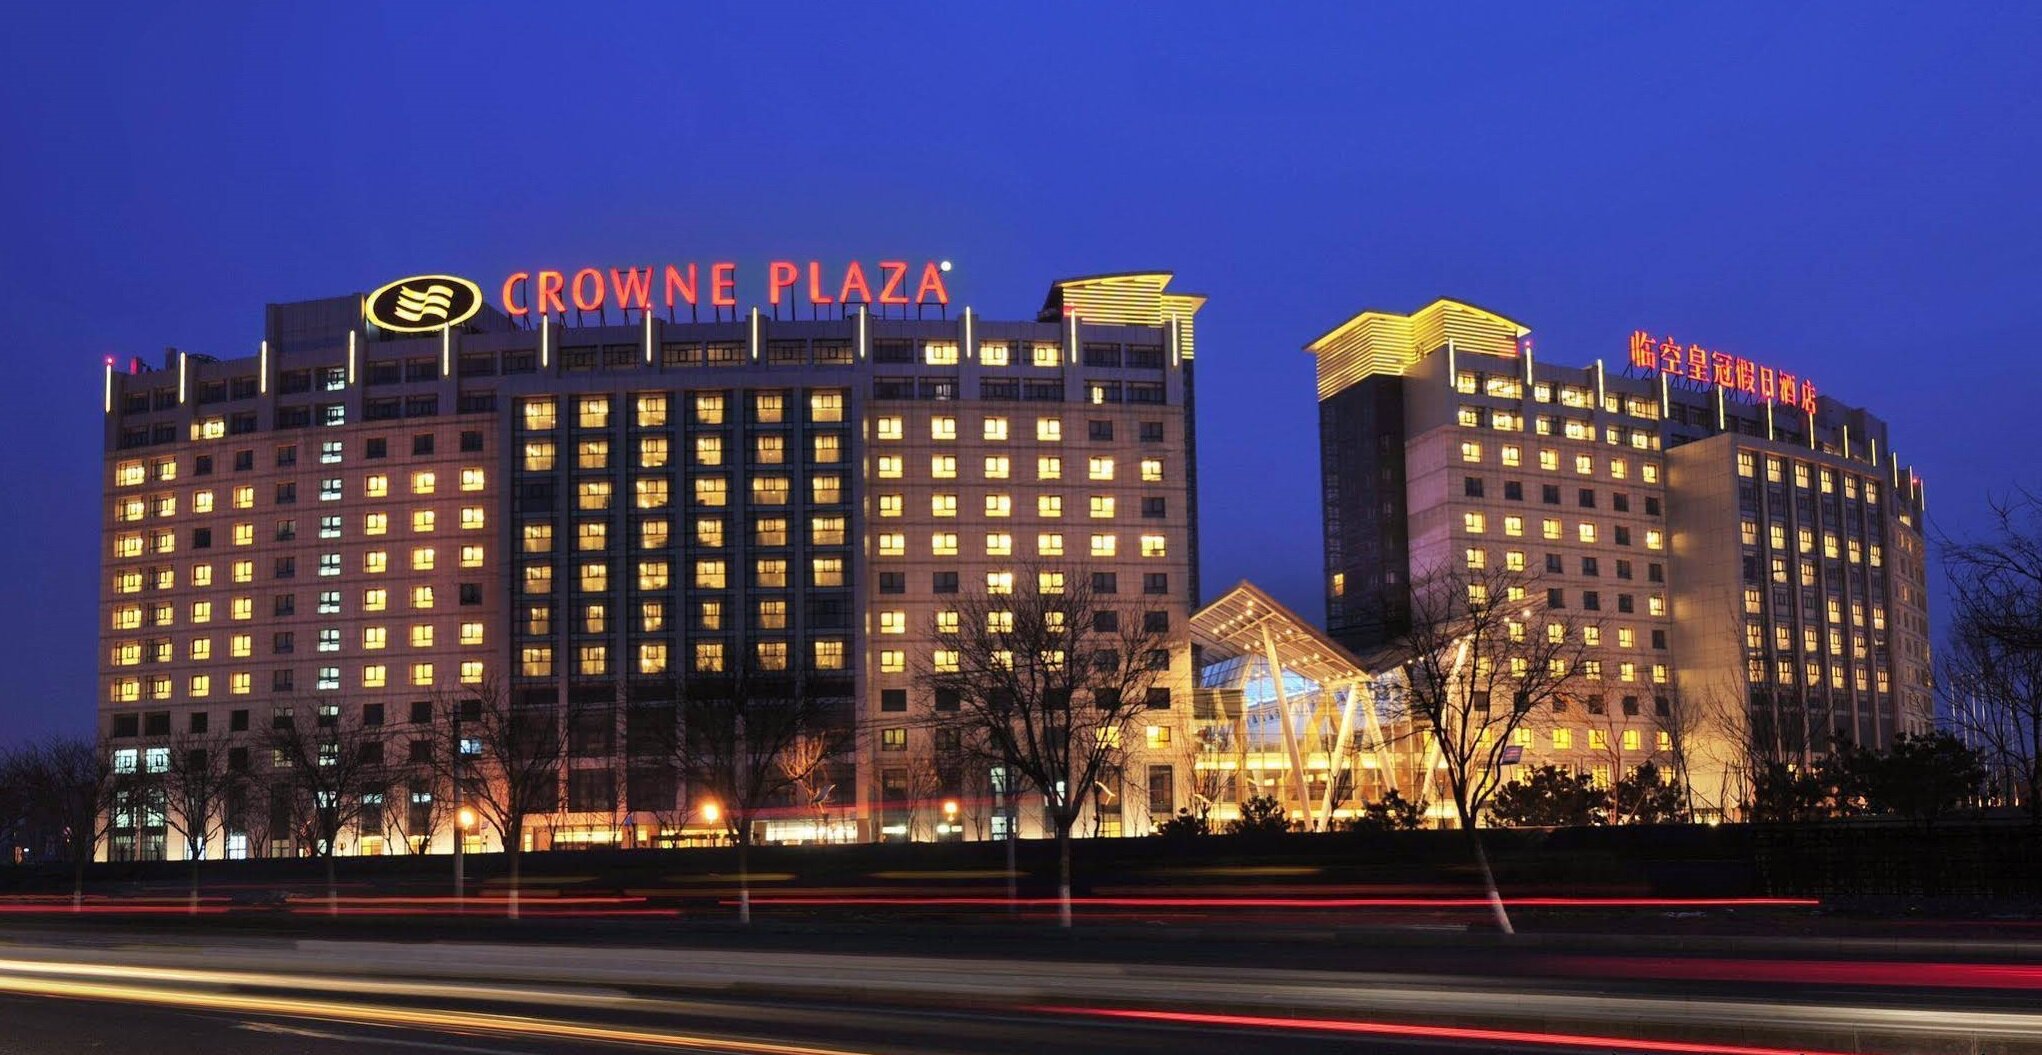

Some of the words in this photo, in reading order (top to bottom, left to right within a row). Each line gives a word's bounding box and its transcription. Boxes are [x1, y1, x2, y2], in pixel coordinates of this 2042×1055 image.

[502, 264, 736, 315] CROWNE
[769, 261, 949, 304] PLAZA
[1630, 330, 1816, 414] 临空皇冠假日酒店
